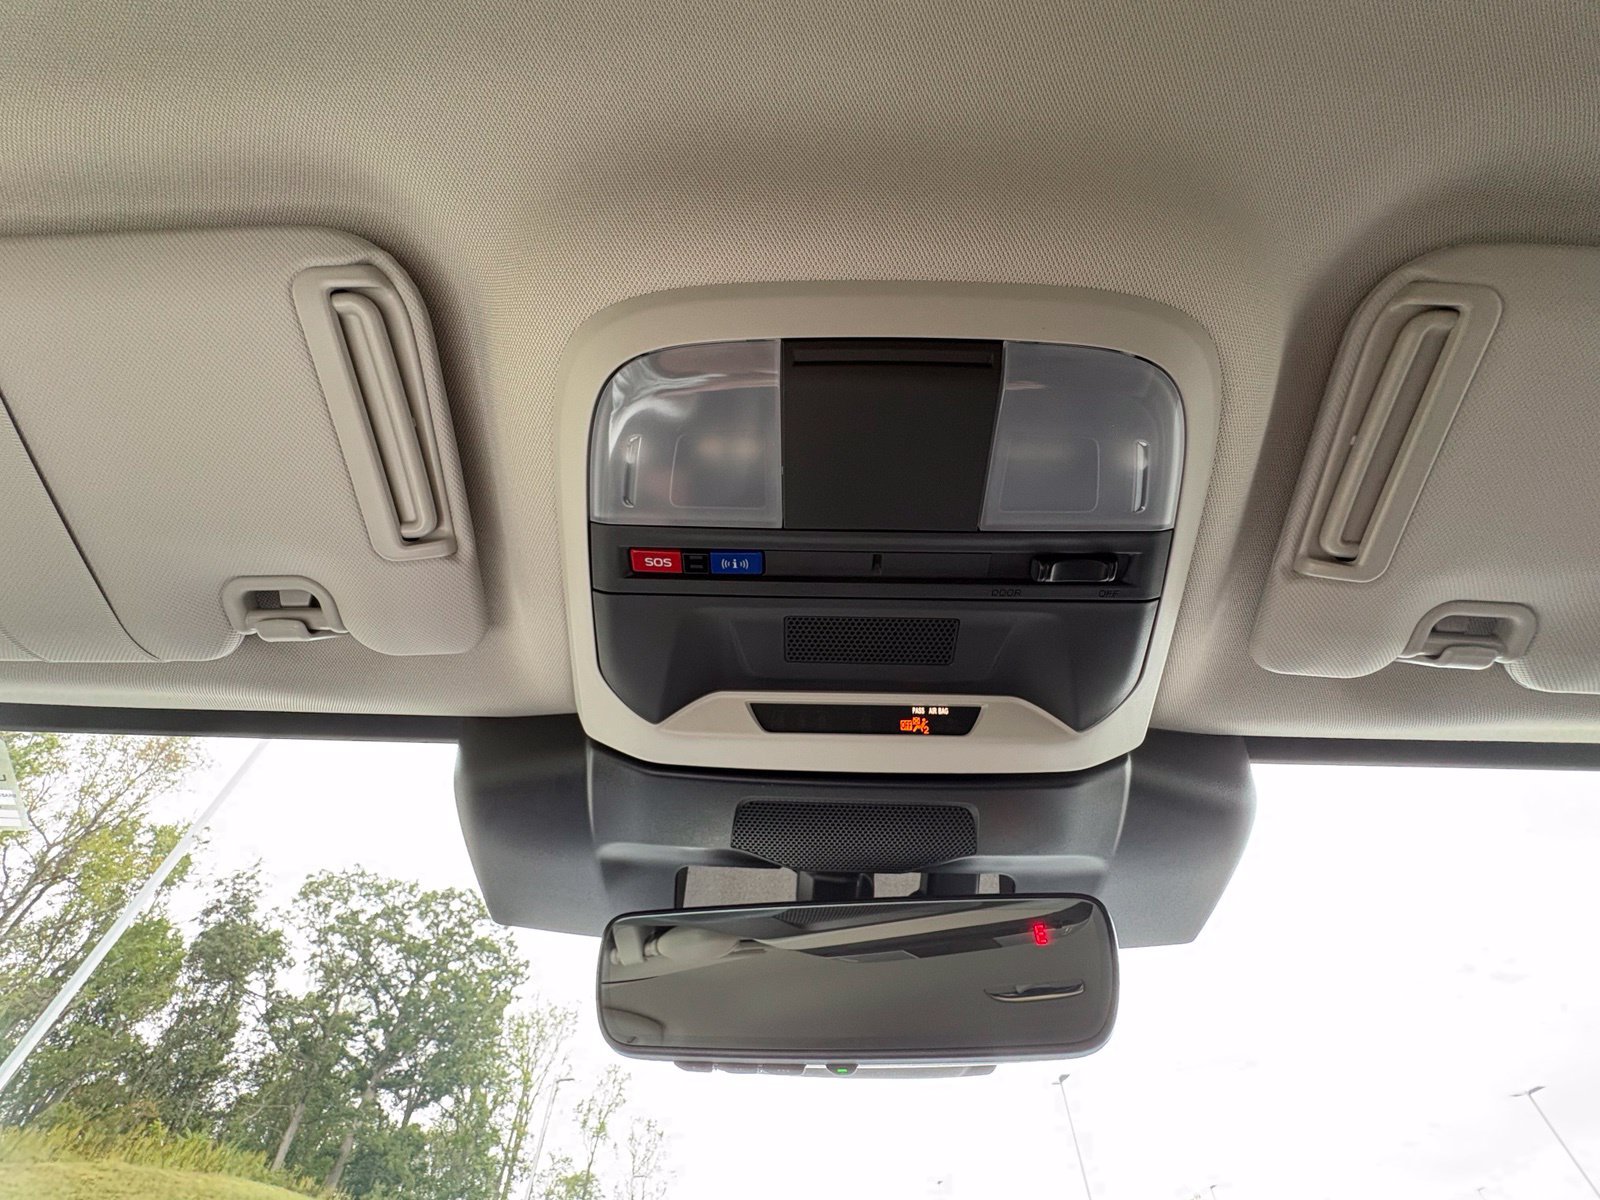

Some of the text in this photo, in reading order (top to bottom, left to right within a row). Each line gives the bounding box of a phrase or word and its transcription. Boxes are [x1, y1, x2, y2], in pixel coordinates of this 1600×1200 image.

[644, 557, 672, 568] SOS
[991, 589, 1022, 597] DOOR
[1099, 589, 1121, 598] OFF
[911, 706, 949, 715] PASS AIR BAG
[923, 725, 930, 734] 2
[1034, 923, 1047, 945] E
